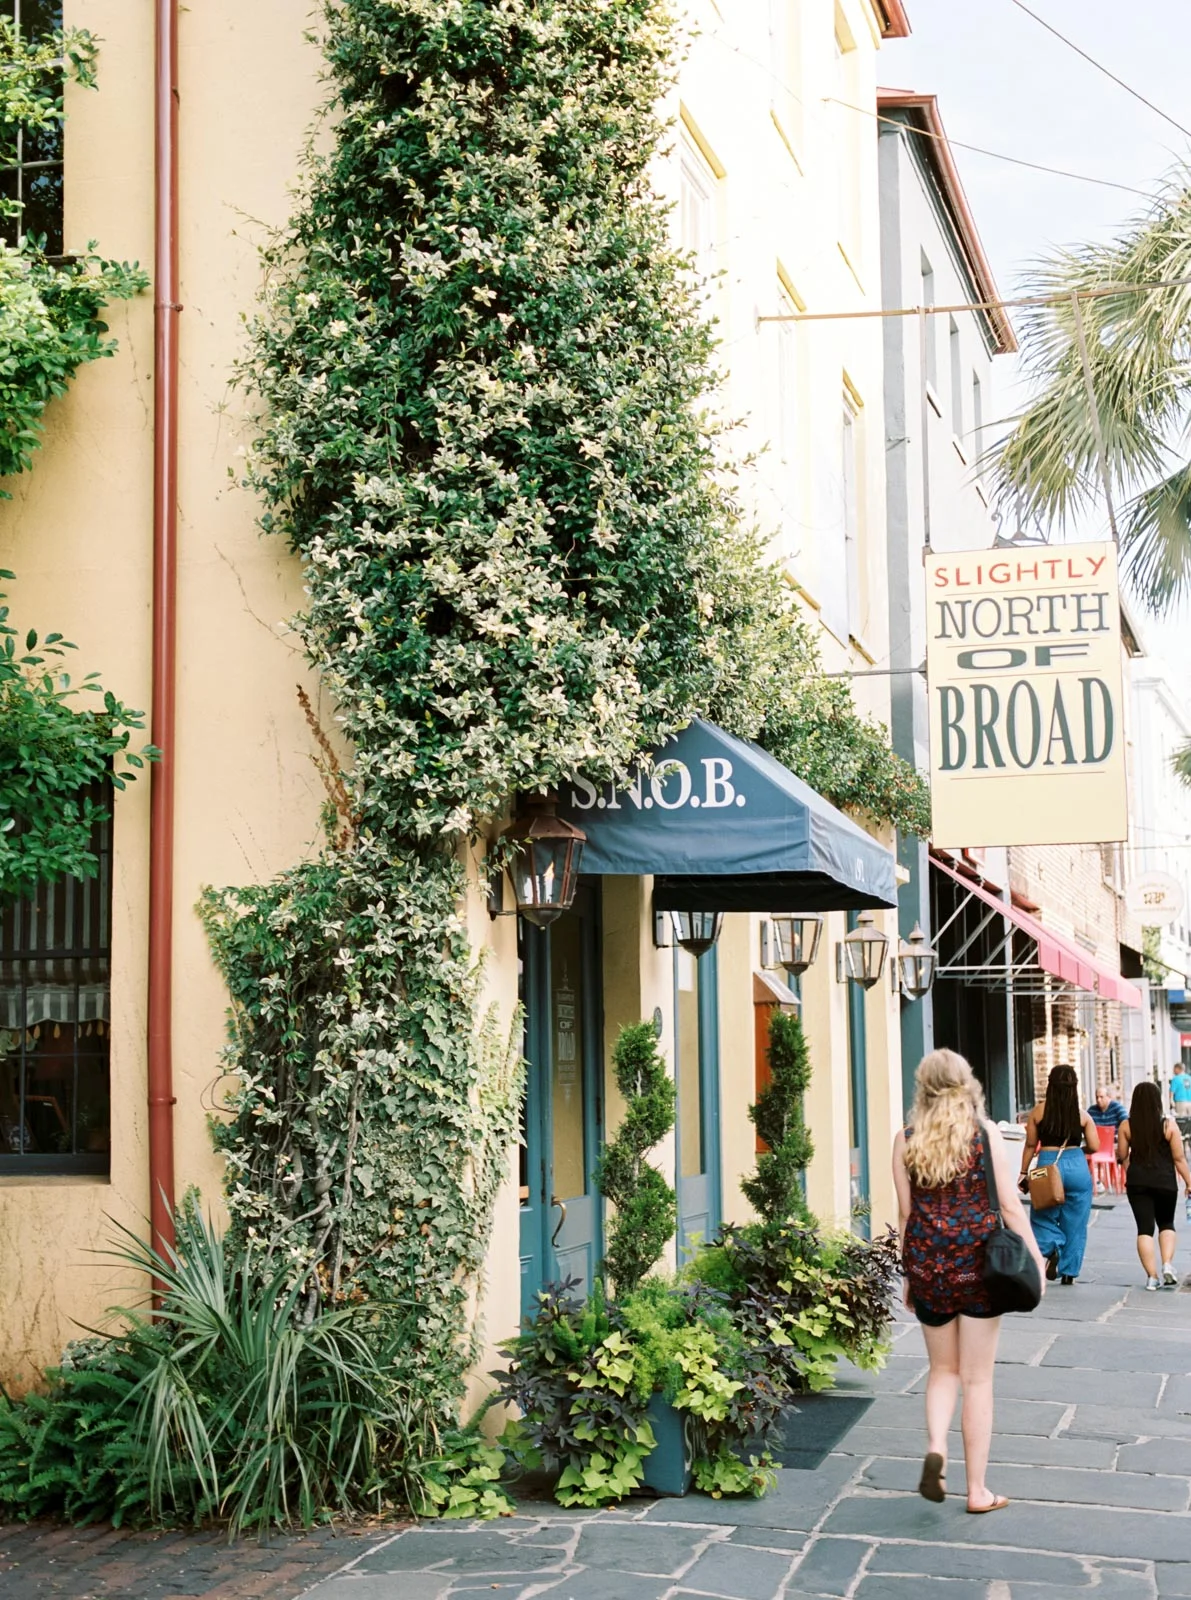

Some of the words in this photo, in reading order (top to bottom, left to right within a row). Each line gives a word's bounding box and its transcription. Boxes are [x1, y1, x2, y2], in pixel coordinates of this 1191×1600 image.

[934, 556, 1106, 588] SLIGHTLY
[934, 592, 1110, 639] NORTH
[957, 643, 1089, 670] OF
[936, 677, 1113, 771] BROAD
